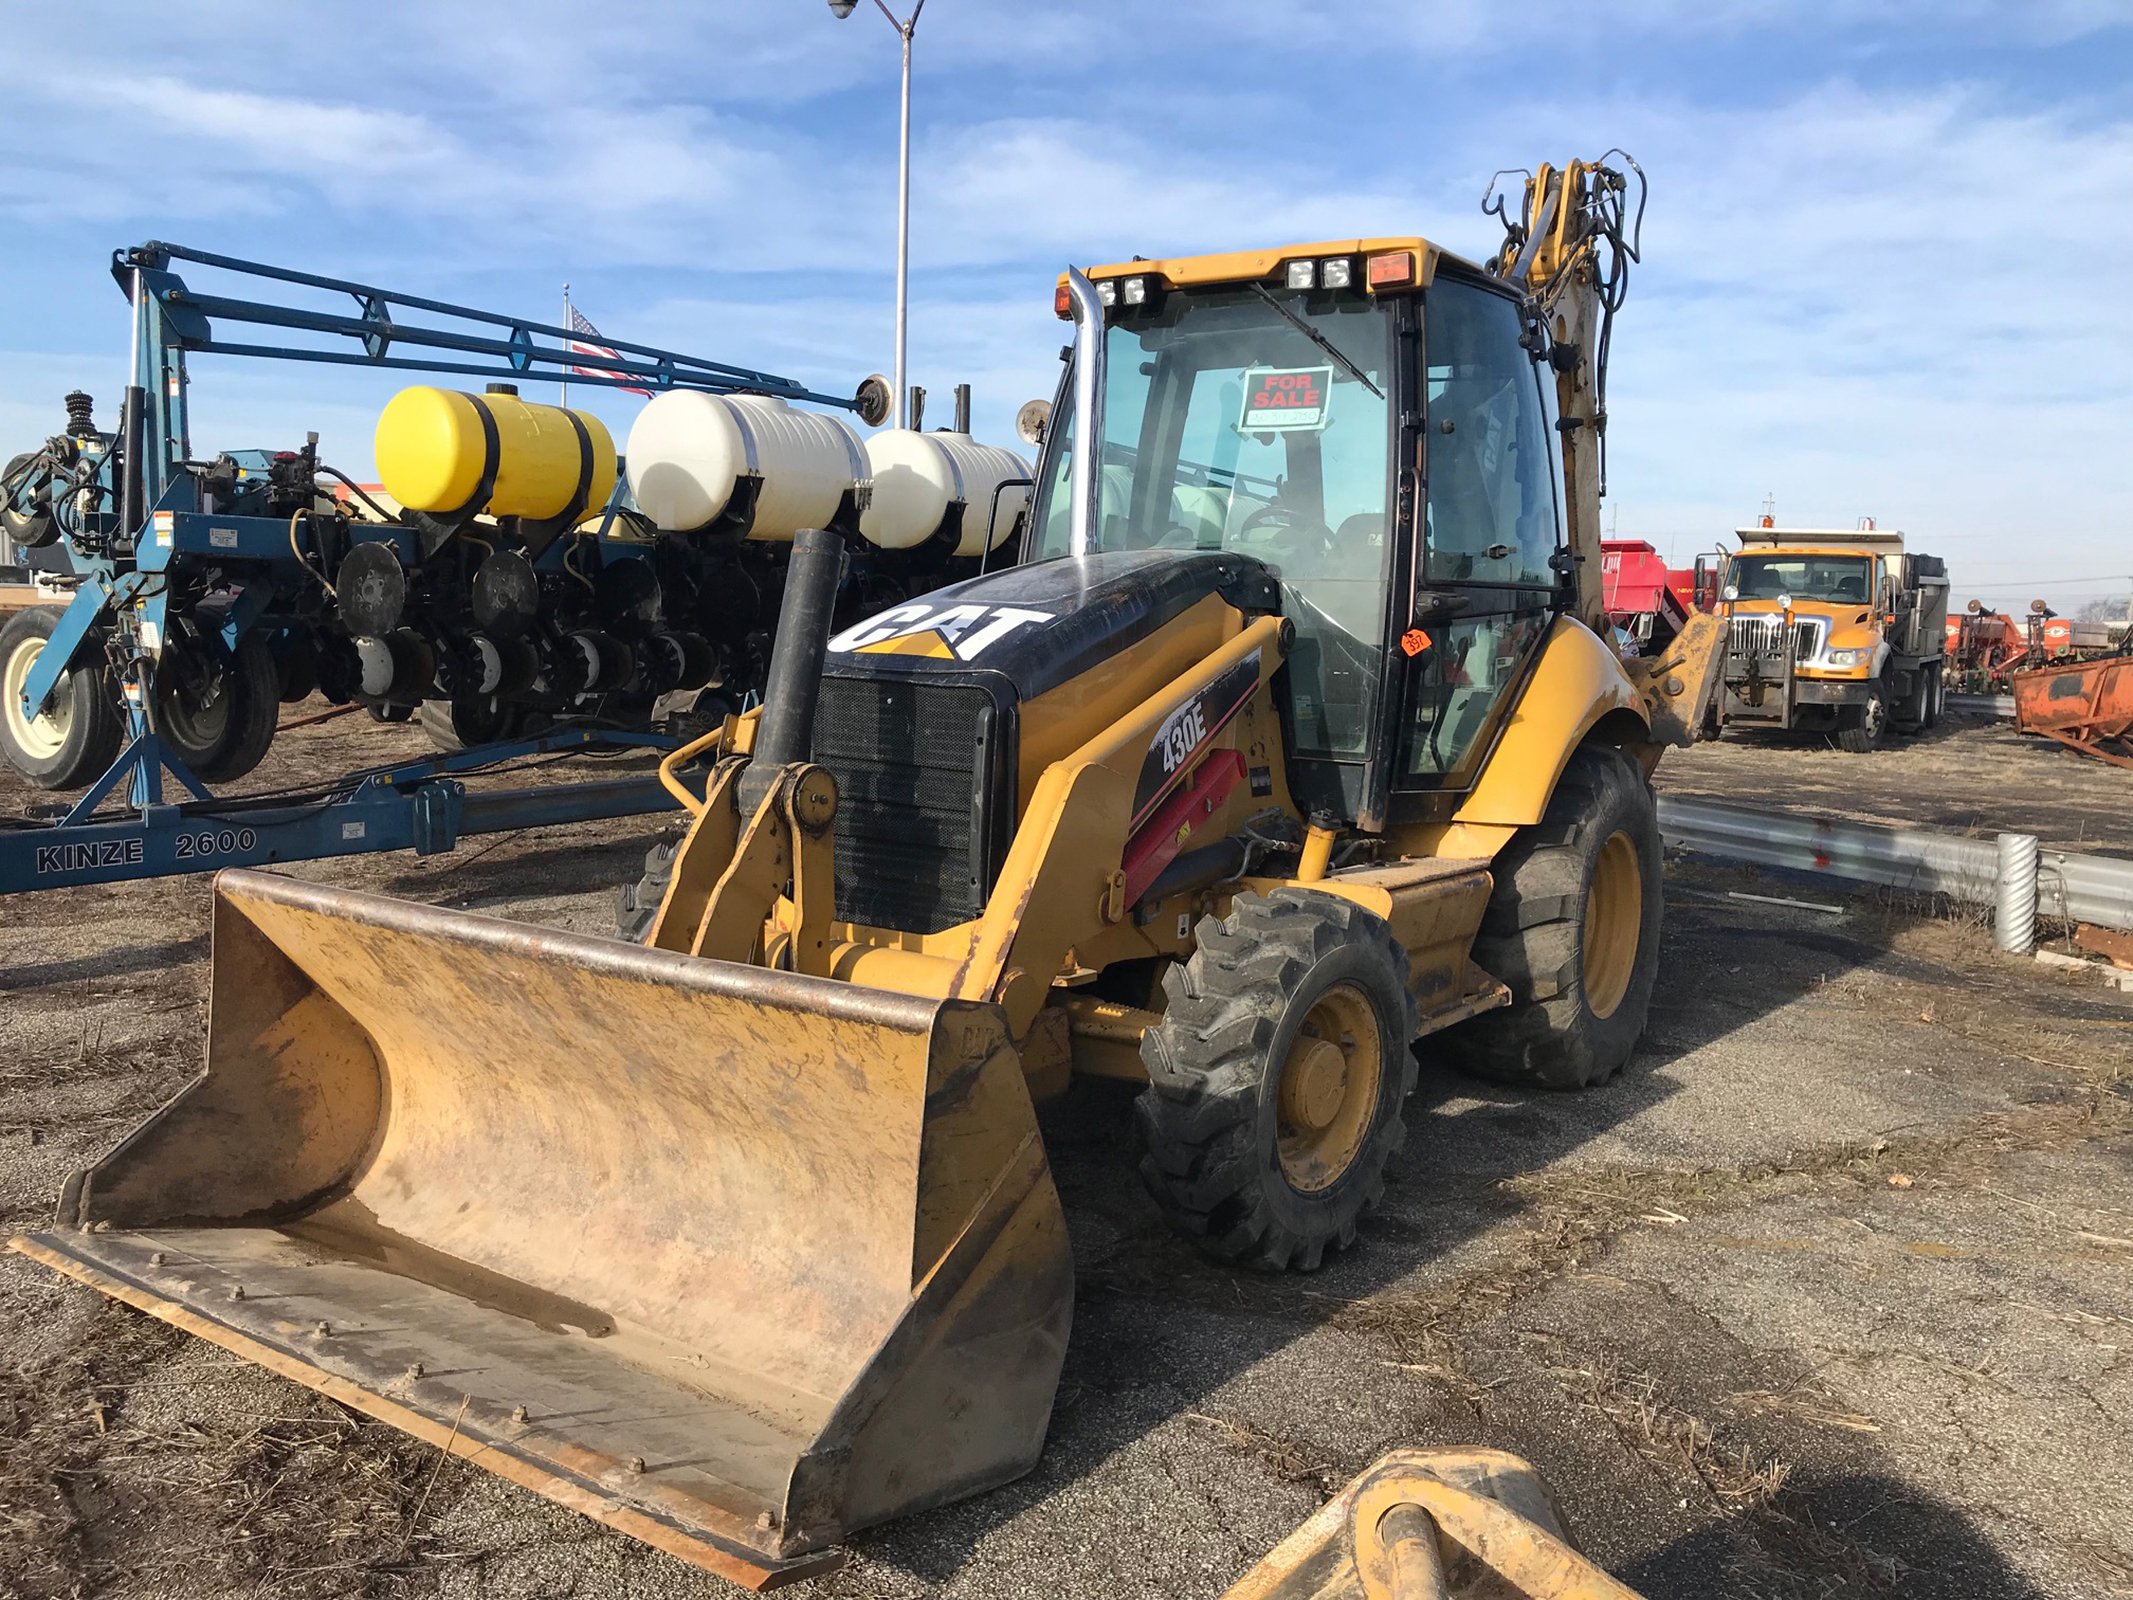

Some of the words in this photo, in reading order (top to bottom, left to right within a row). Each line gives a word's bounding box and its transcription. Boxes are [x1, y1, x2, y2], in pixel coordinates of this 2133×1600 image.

[1264, 374, 1312, 390] FOR
[1253, 390, 1319, 407] SALE
[1367, 533, 1385, 546] CA
[826, 604, 1057, 662] CAT
[1163, 699, 1208, 774] 430E
[37, 837, 144, 874] KINZE
[175, 828, 257, 859] 2600
